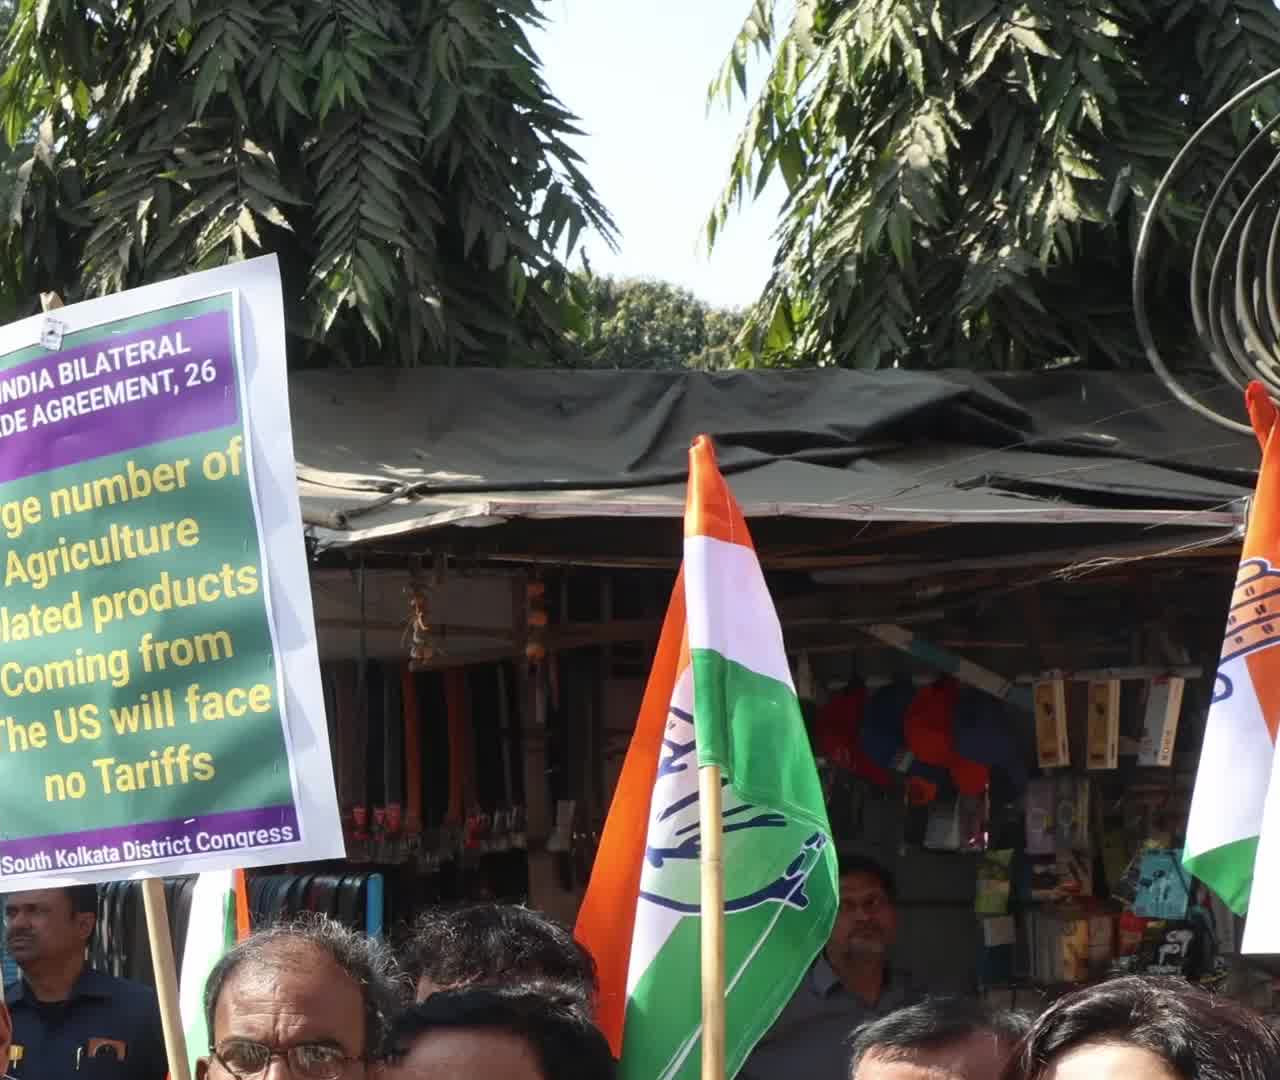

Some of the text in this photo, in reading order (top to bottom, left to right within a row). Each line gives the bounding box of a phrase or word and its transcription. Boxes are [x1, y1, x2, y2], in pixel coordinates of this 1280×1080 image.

[58, 333, 191, 386] BILATERAL
[32, 370, 179, 428] AGREEMENT,
[185, 360, 217, 386] 26
[51, 461, 189, 519] number
[203, 435, 246, 482] of
[3, 517, 200, 590] Agriculture
[92, 561, 259, 636] products
[0, 630, 234, 700] Coming from
[54, 702, 102, 742] US
[110, 693, 175, 736] will
[185, 682, 273, 724] face
[45, 744, 216, 802] no Tariffs
[2, 823, 295, 876] South Kolkata District Congress
